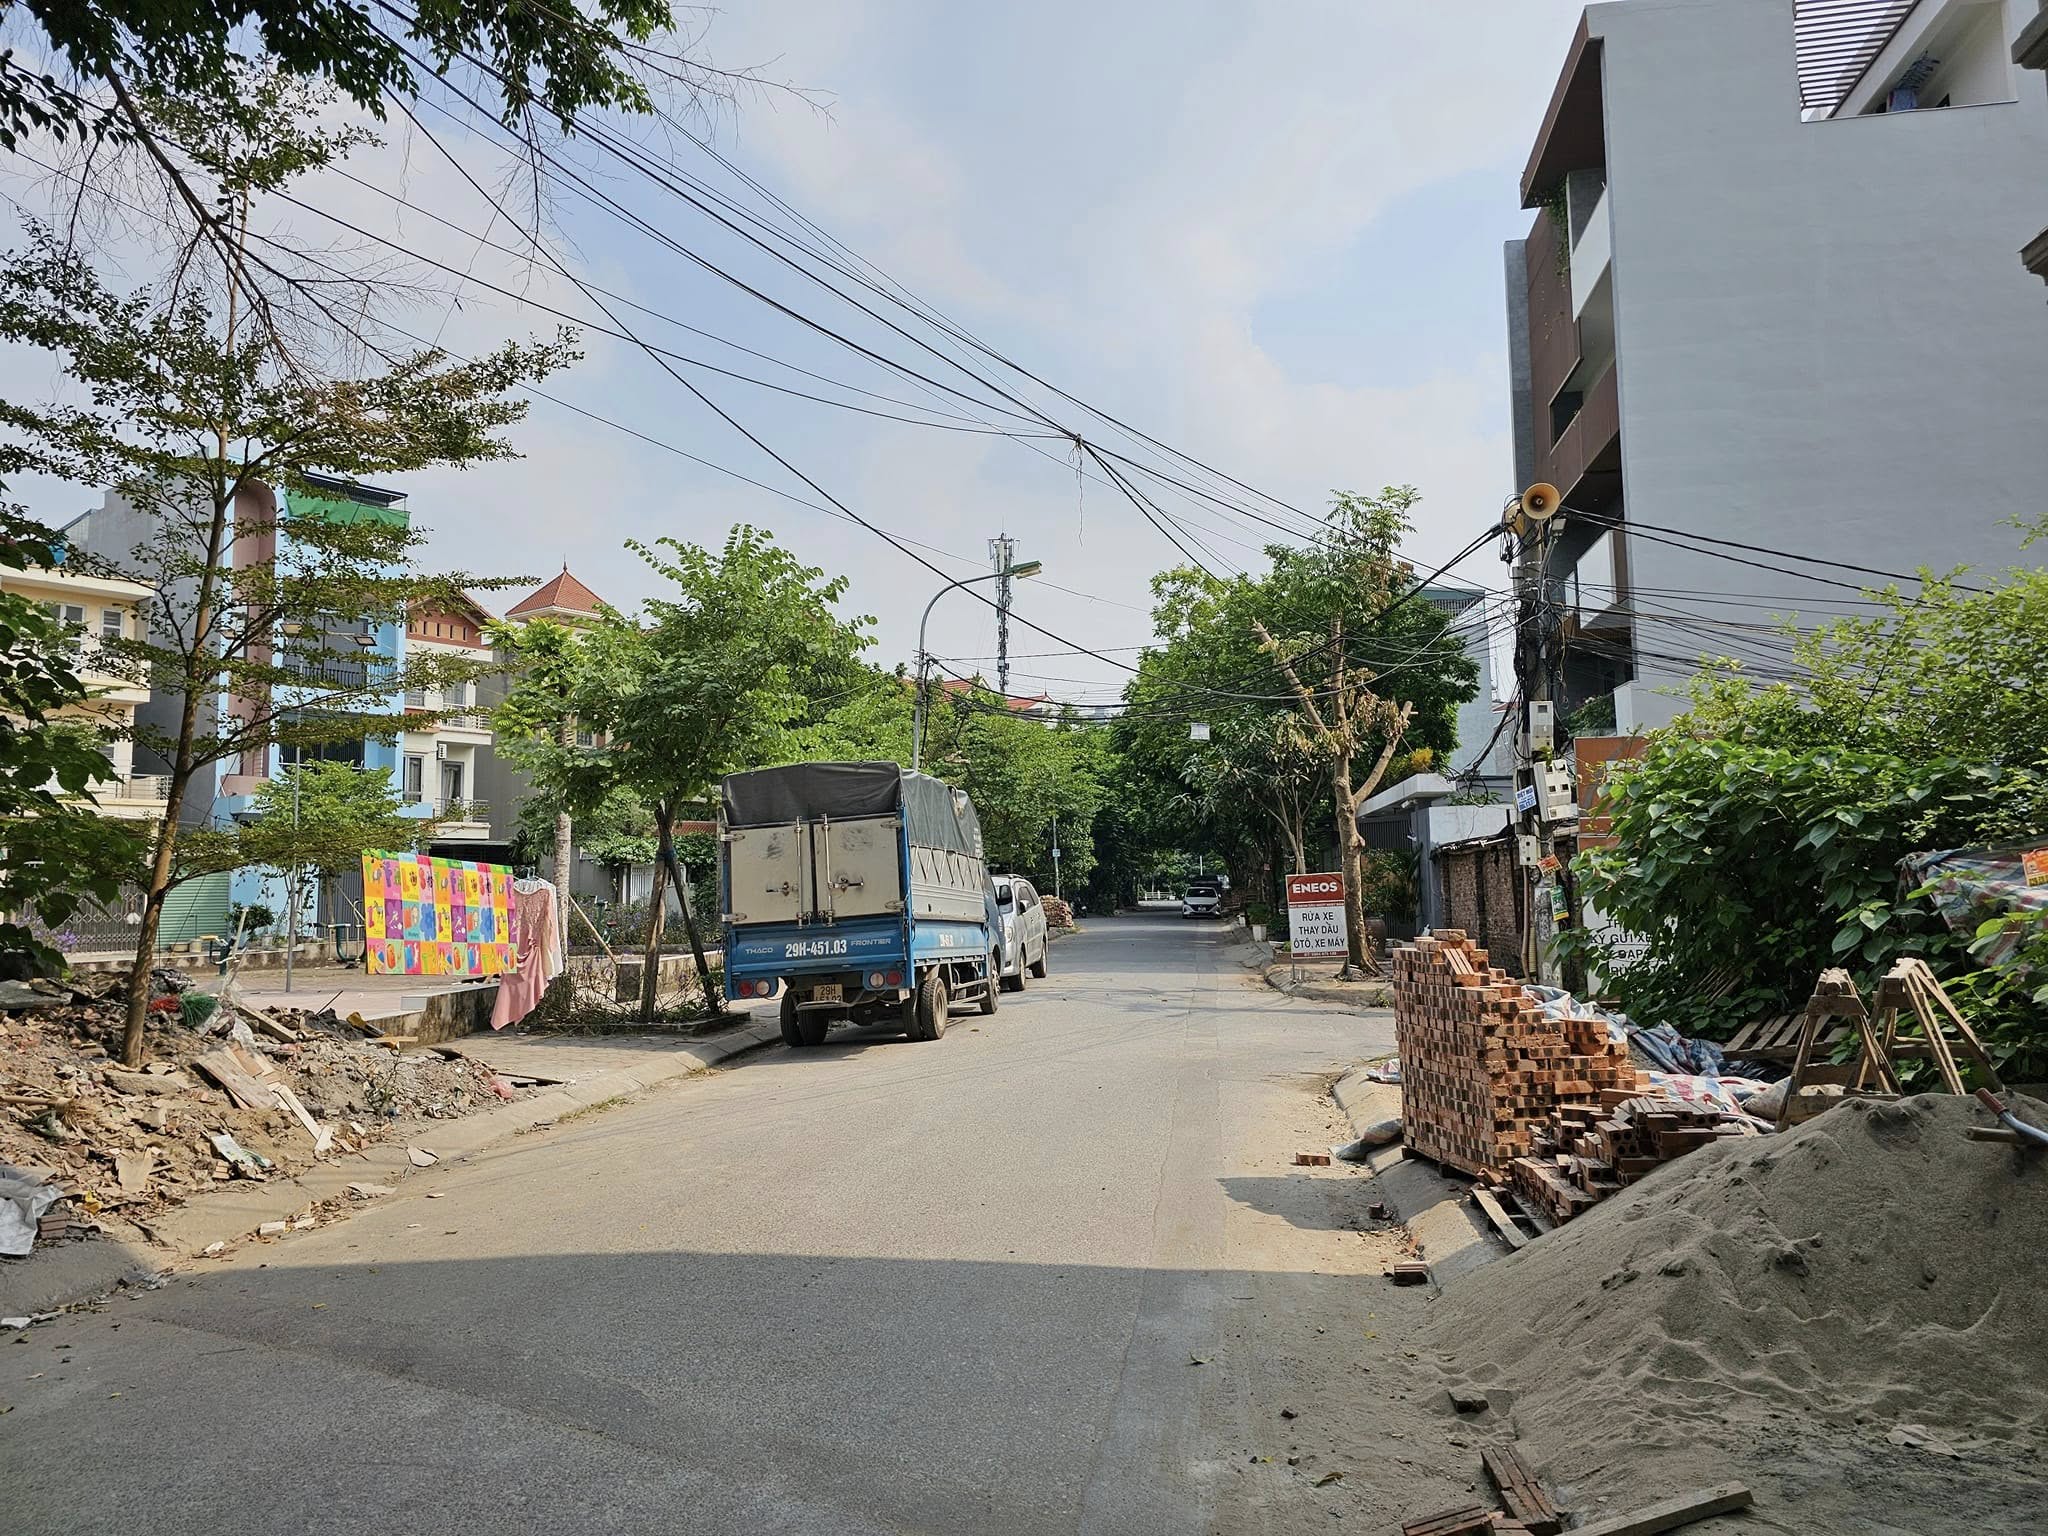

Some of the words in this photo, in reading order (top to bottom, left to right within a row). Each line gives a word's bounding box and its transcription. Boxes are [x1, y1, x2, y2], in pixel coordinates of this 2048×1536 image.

[1292, 882, 1338, 894] ENEOS
[1323, 912, 1334, 921] XE
[1298, 926, 1319, 935] THAY
[1321, 921, 1339, 934] DẦU
[745, 947, 774, 955] THACO
[785, 939, 847, 958] 29H-451.03
[851, 938, 892, 947] FRONTIER
[1315, 938, 1326, 948] XE
[1327, 936, 1345, 947] MÁY
[820, 985, 836, 996] 29H
